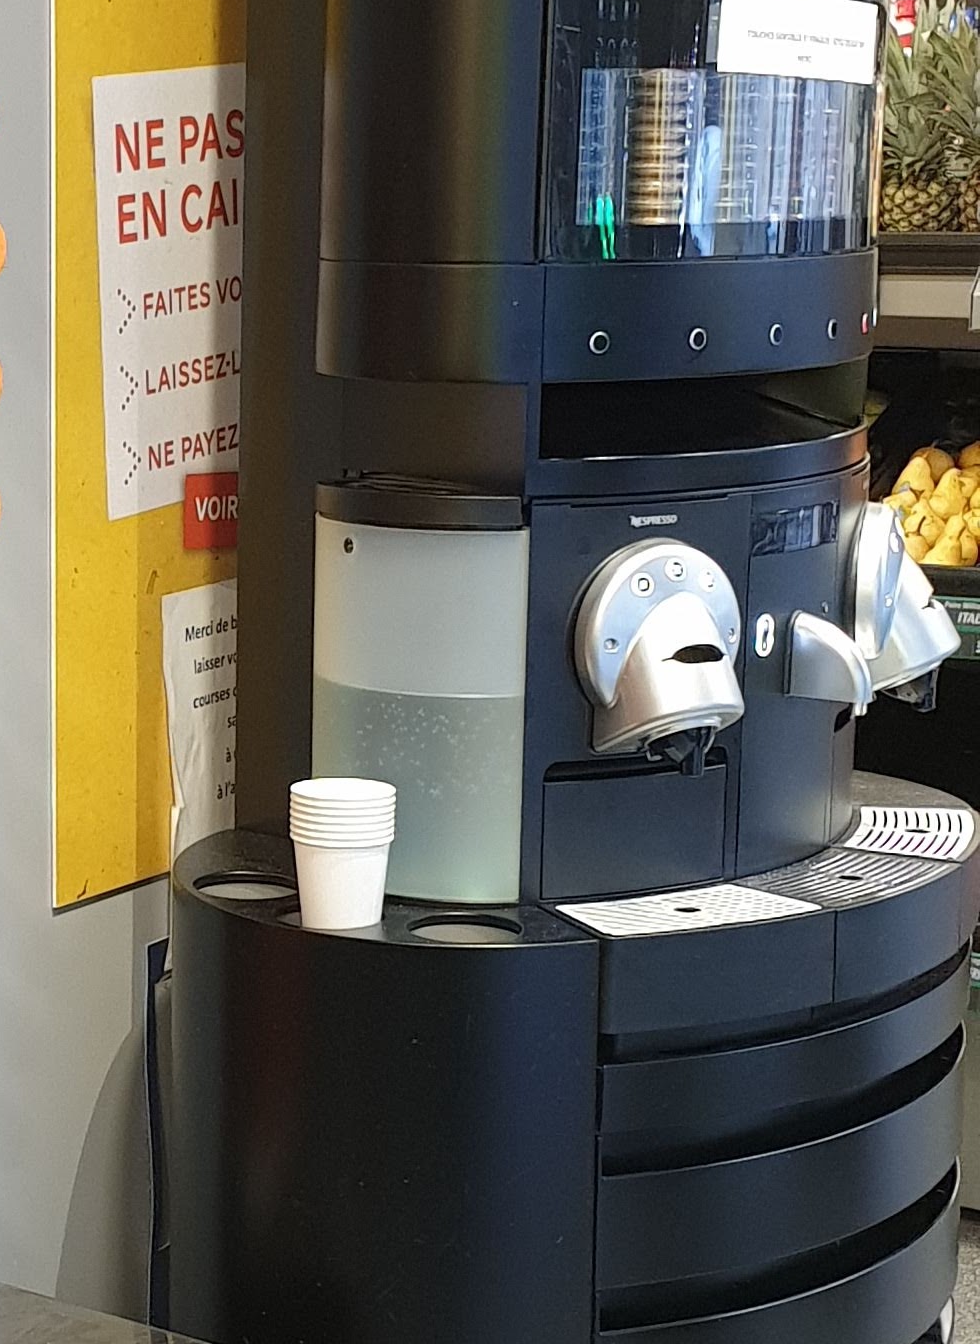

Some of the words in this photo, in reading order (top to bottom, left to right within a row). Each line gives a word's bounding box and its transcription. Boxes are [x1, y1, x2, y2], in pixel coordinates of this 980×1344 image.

[115, 118, 166, 174] NE
[179, 109, 245, 165] PAS
[117, 189, 167, 245] EN
[143, 281, 211, 320] FAITES
[148, 439, 175, 471] NE
[181, 423, 239, 462] PAYEZ
[195, 494, 239, 523] VOIR
[185, 619, 214, 643] Merci
[215, 617, 229, 634] de
[193, 654, 226, 675] laisser
[193, 687, 231, 709] courses
